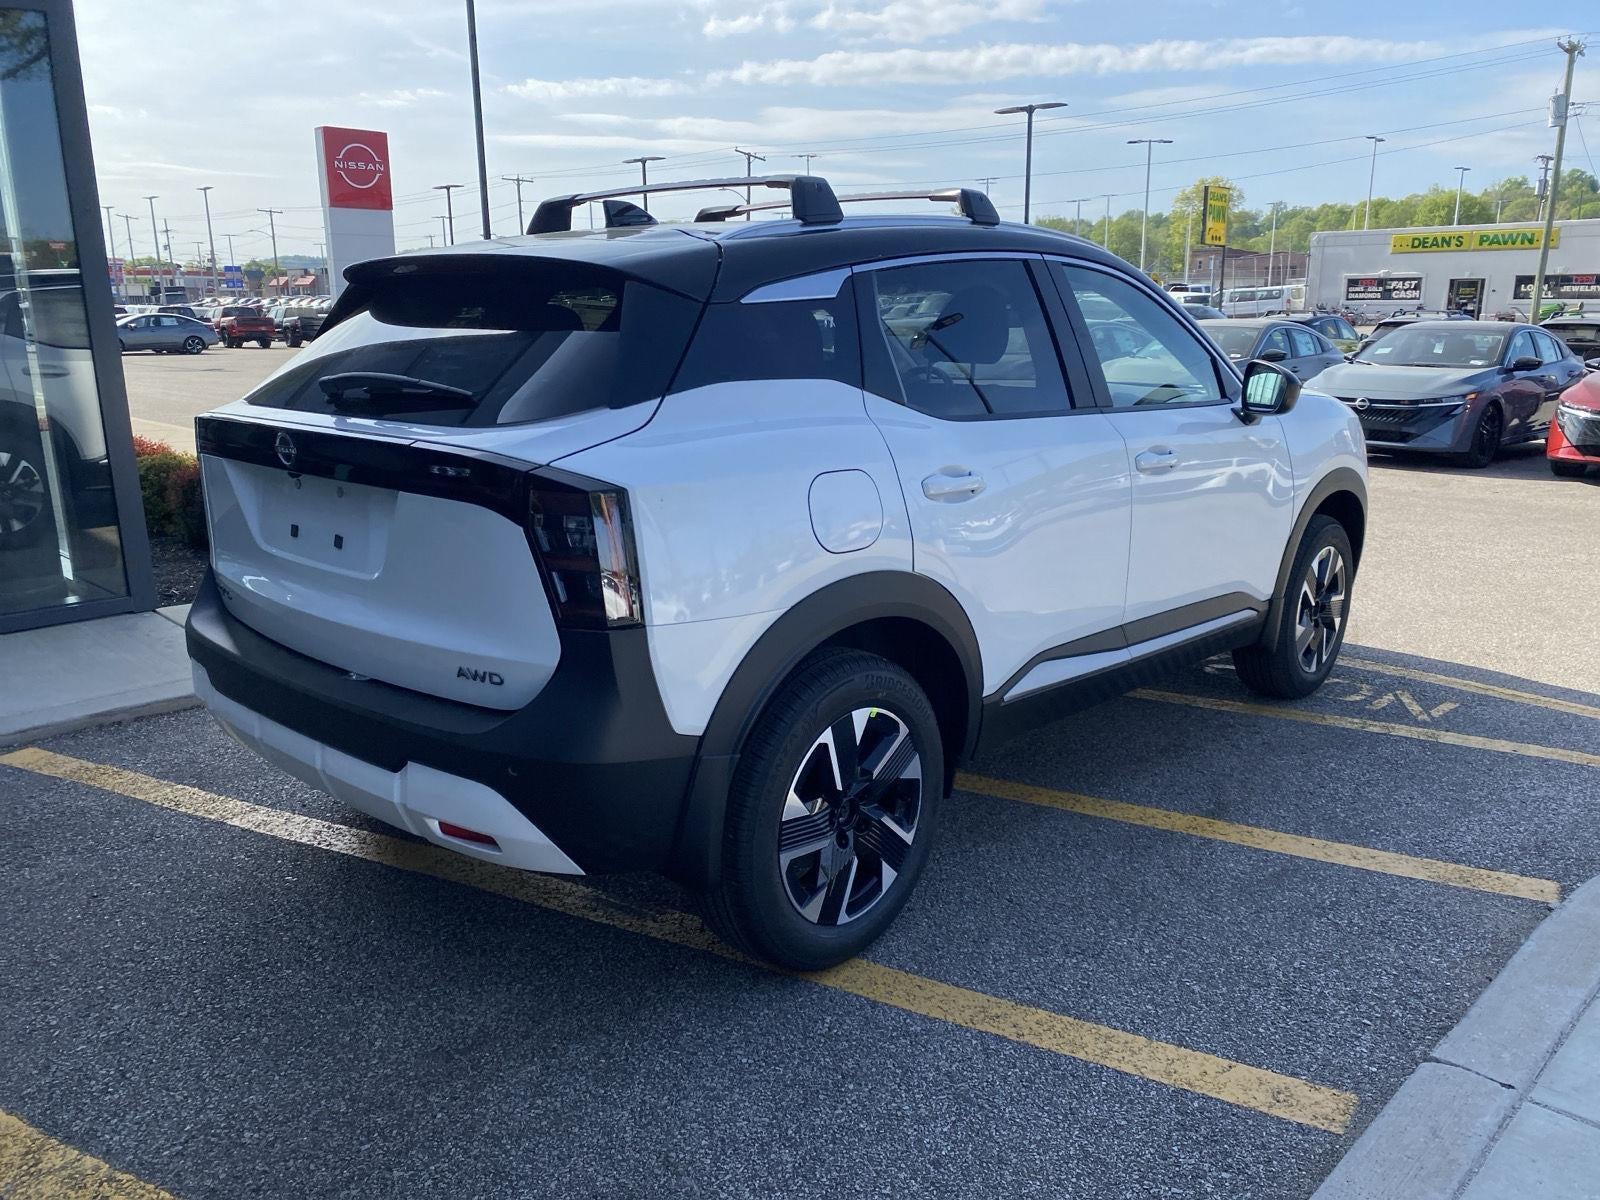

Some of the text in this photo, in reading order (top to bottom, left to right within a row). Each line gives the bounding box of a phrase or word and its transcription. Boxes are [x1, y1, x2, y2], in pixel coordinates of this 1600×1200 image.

[334, 160, 384, 171] NISSAN
[1410, 232, 1536, 249] DEAN'S PAWN
[1391, 280, 1418, 289] FAST
[1521, 284, 1548, 292] LON
[1392, 290, 1420, 299] CASH
[456, 666, 505, 686] AWD
